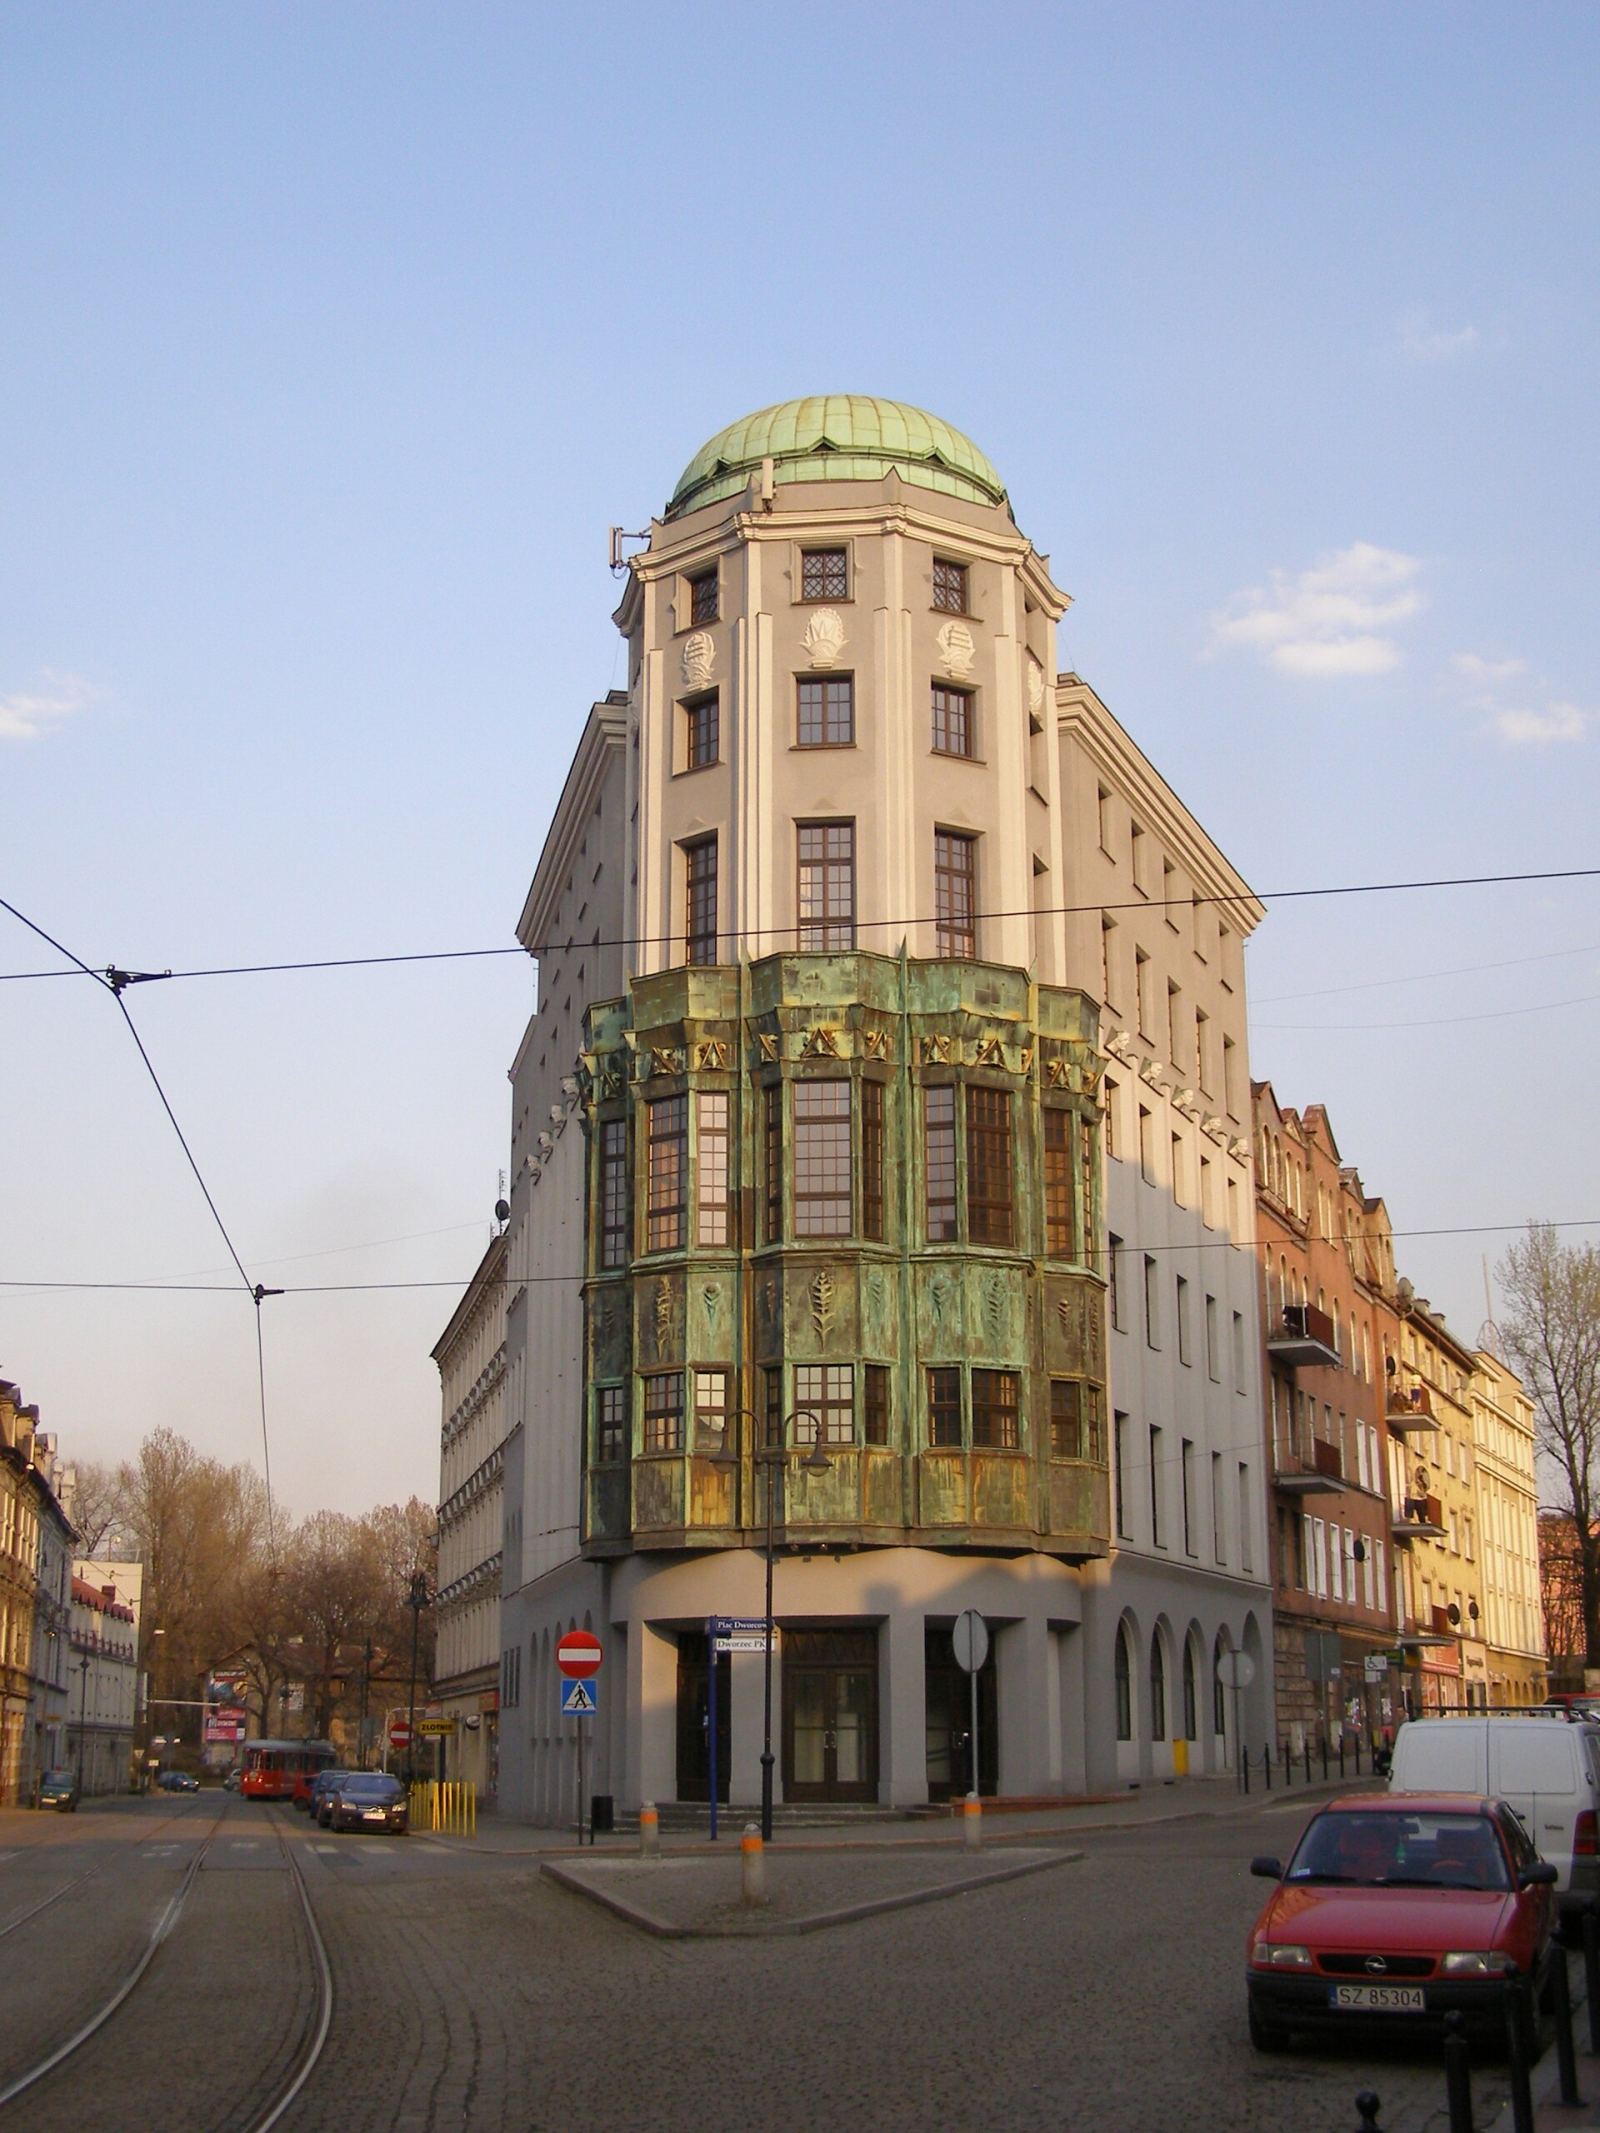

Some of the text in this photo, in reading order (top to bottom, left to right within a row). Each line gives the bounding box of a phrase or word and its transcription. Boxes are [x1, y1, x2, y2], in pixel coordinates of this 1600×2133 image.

[718, 1621, 768, 1629] Plac Dworcow
[718, 1640, 752, 1648] Dworzec
[1339, 1988, 1422, 2006] SZ 85304
